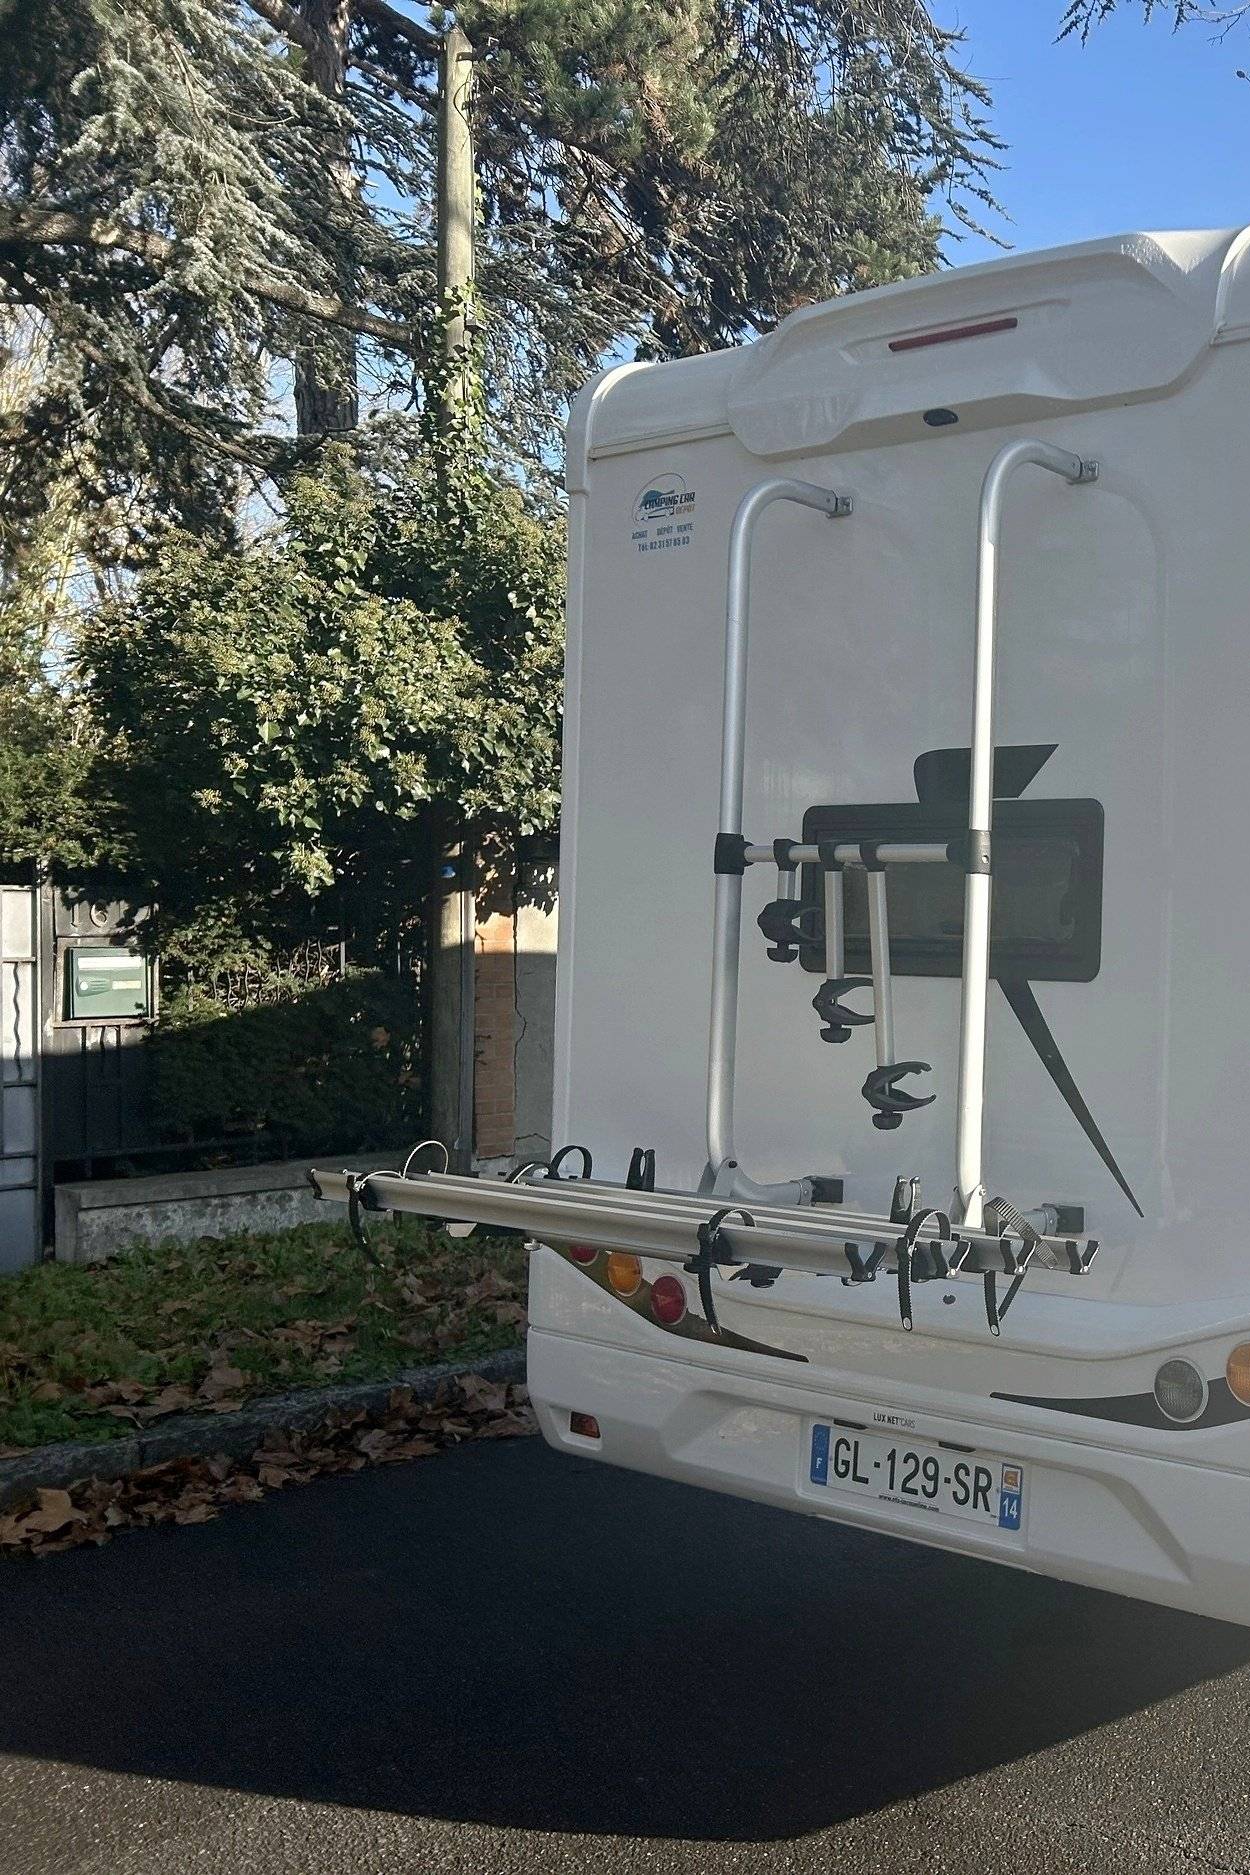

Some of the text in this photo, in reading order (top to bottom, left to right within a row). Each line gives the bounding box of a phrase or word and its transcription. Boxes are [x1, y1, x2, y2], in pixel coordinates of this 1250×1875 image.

[644, 491, 696, 510] CAMPING CAR
[873, 1412, 886, 1424] LUX
[833, 1437, 993, 1513] GL-129-SR
[1002, 1497, 1018, 1519] 14
